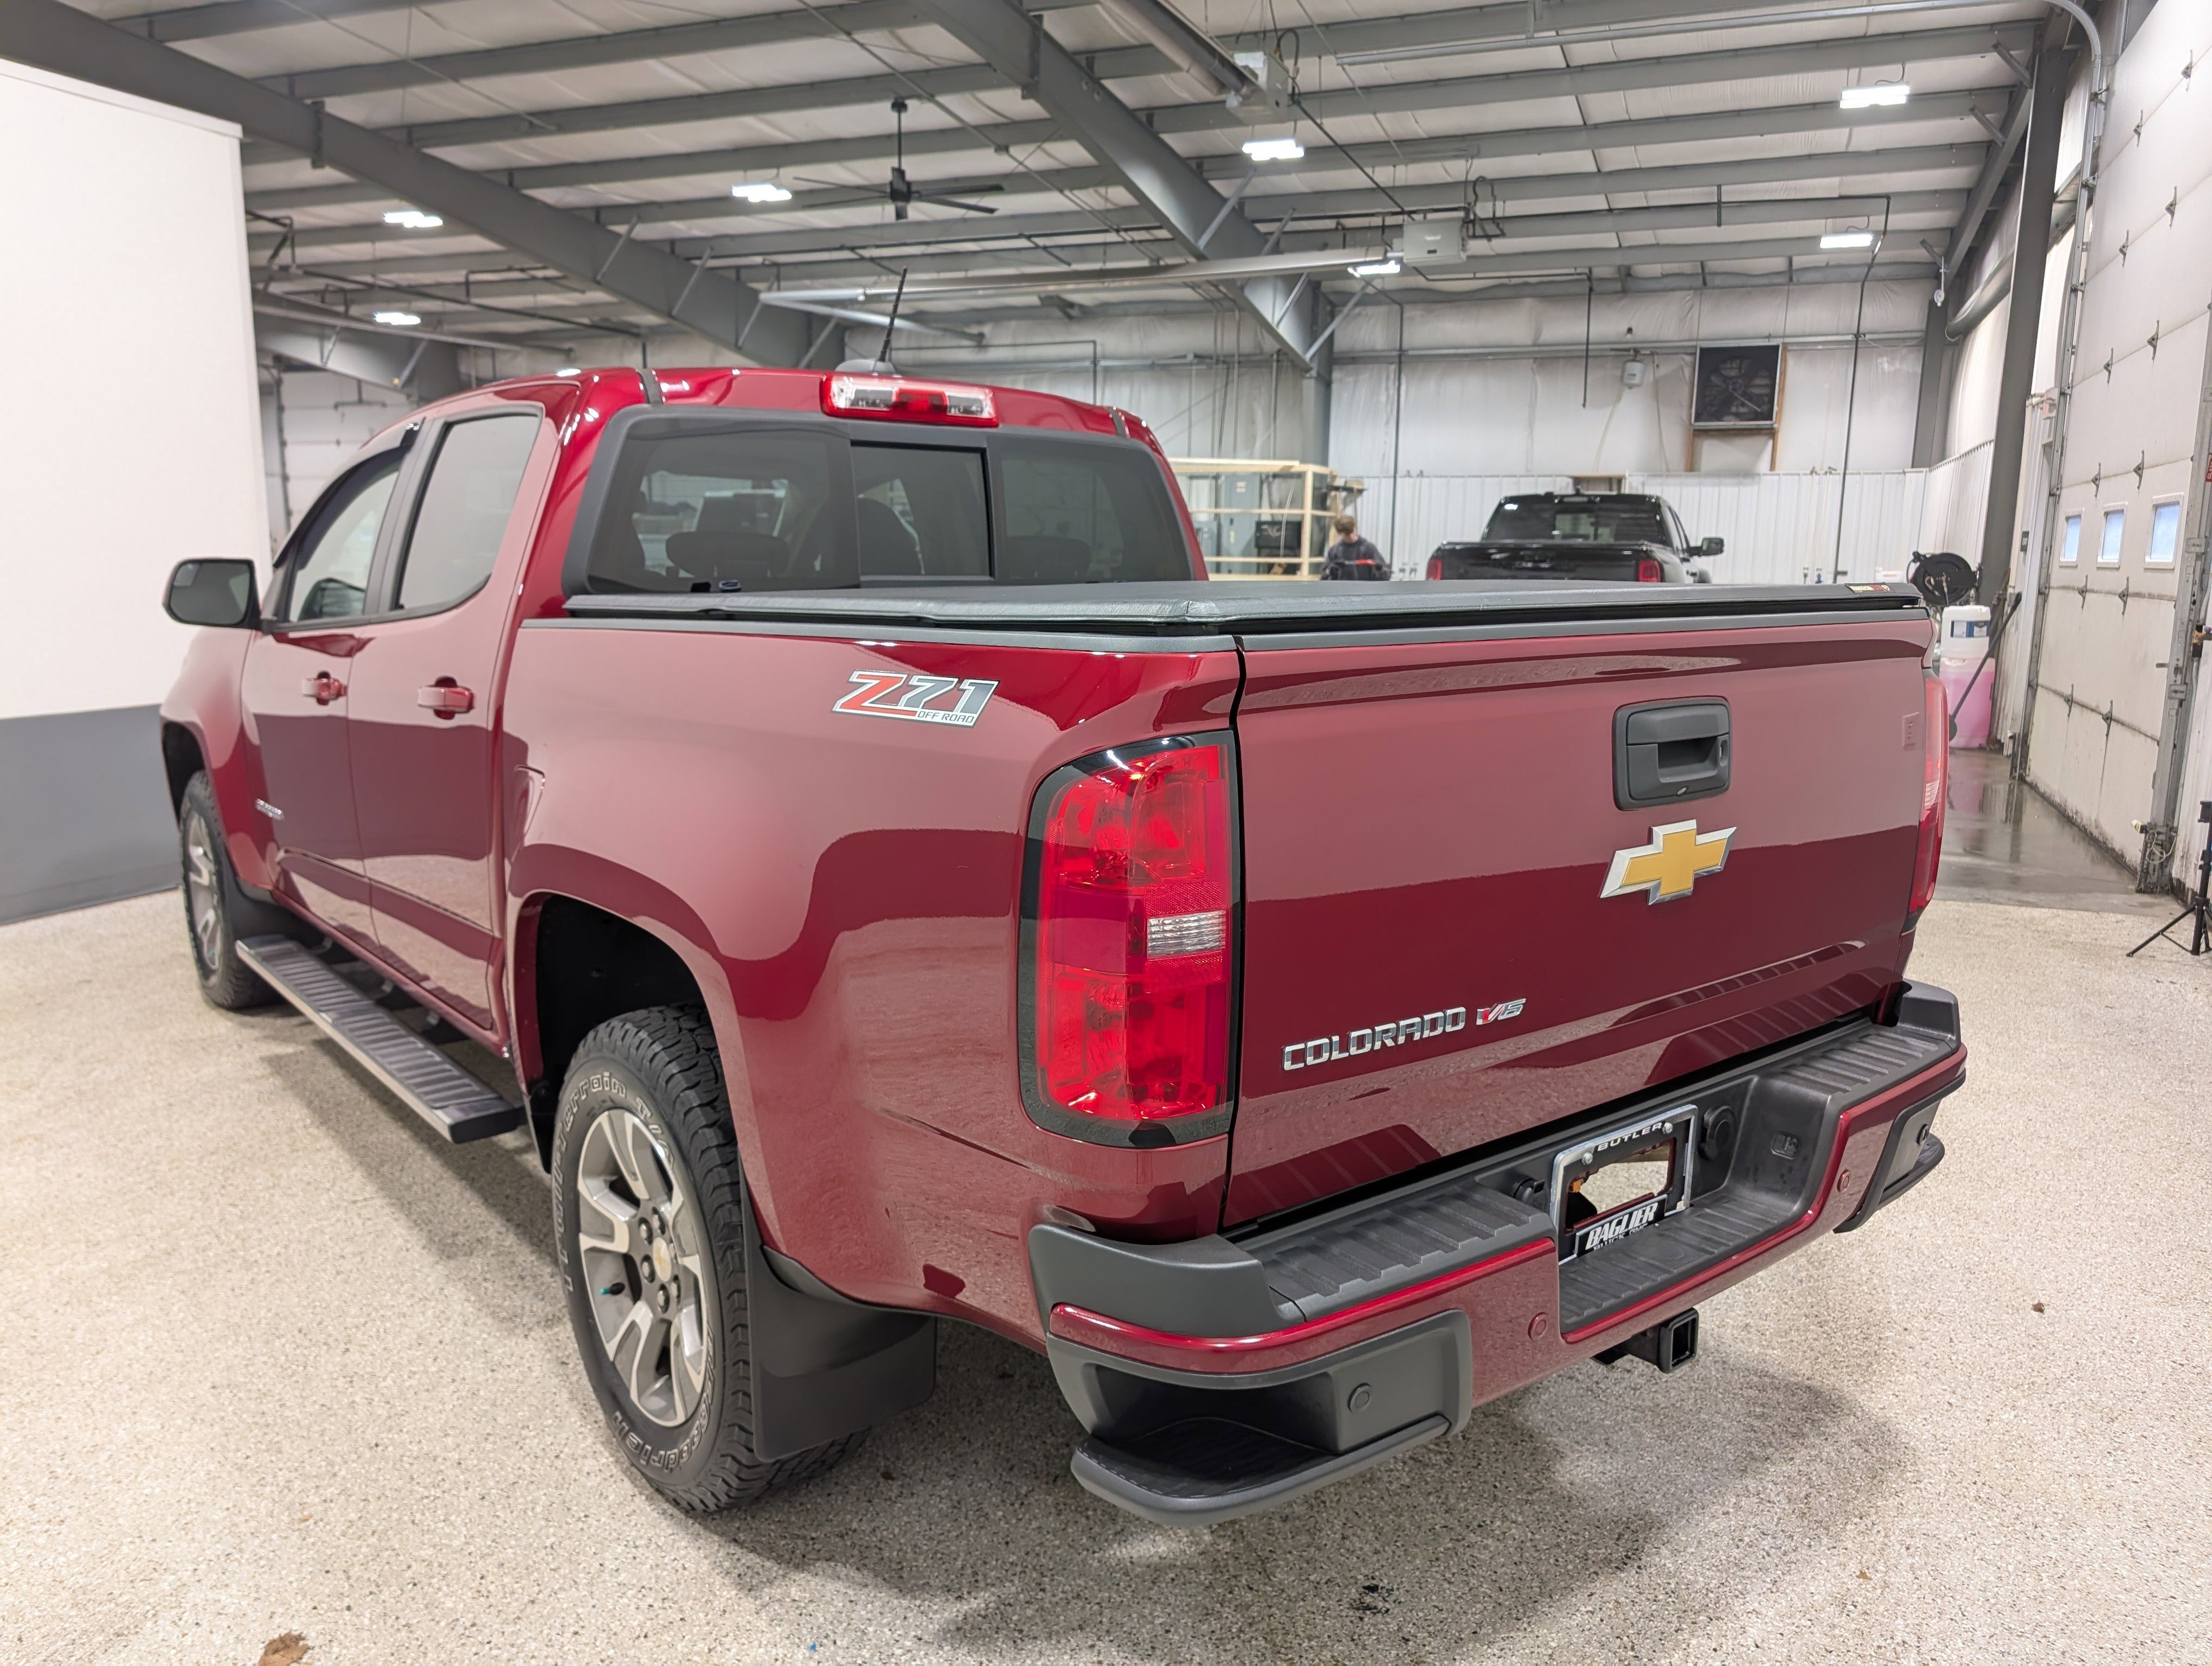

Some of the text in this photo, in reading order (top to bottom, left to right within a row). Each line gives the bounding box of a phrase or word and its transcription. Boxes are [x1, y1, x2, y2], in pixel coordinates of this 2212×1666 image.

[833, 670, 999, 722] Z71
[917, 710, 975, 723] OFF ROAD
[1282, 998, 1526, 1071] COLORADO V6
[1597, 1122, 1662, 1151] BUTLER
[1585, 1202, 1658, 1250] BAGLIER
